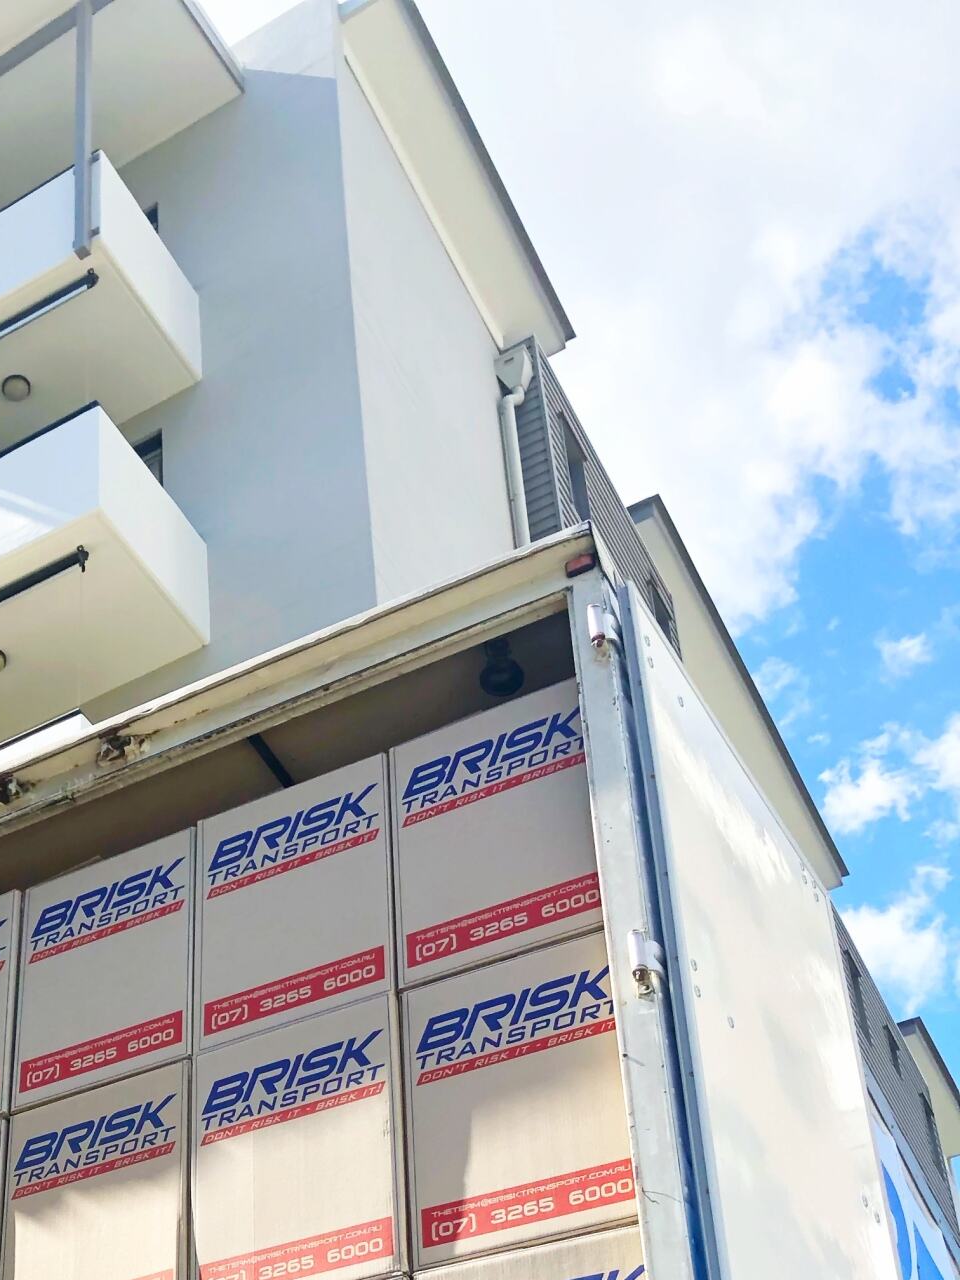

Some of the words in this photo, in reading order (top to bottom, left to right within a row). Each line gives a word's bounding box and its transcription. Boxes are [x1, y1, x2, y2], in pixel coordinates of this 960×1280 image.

[402, 702, 581, 800] BRISK
[402, 732, 585, 813] TRANSPORT
[570, 751, 585, 764] IT
[207, 812, 379, 886] TRANSPORT
[208, 782, 378, 872] BRISK
[30, 885, 185, 951] TRANSPORT
[31, 856, 187, 939] BRISK
[414, 932, 457, 962] (07)
[468, 911, 529, 942] 3265
[540, 887, 601, 919] 6000
[211, 1002, 249, 1030] (07)
[259, 984, 312, 1013] 3265
[323, 963, 376, 992] 6000
[415, 996, 615, 1070] TRANSPORT
[416, 961, 610, 1054] BRISK
[600, 1018, 617, 1031] IT
[26, 1062, 61, 1088] (07)
[69, 1045, 118, 1072] 3265
[127, 1027, 175, 1054] 6000
[201, 1028, 385, 1115] BRISK
[14, 1094, 176, 1172] BRISK
[201, 1063, 384, 1131] TRANSPORT
[13, 1126, 176, 1186] TRANSPORT
[430, 1211, 477, 1242] (07)
[489, 1196, 555, 1225] 3265
[568, 1177, 633, 1207] 6000
[258, 1254, 315, 1280] 3265
[326, 1236, 383, 1264] 6000
